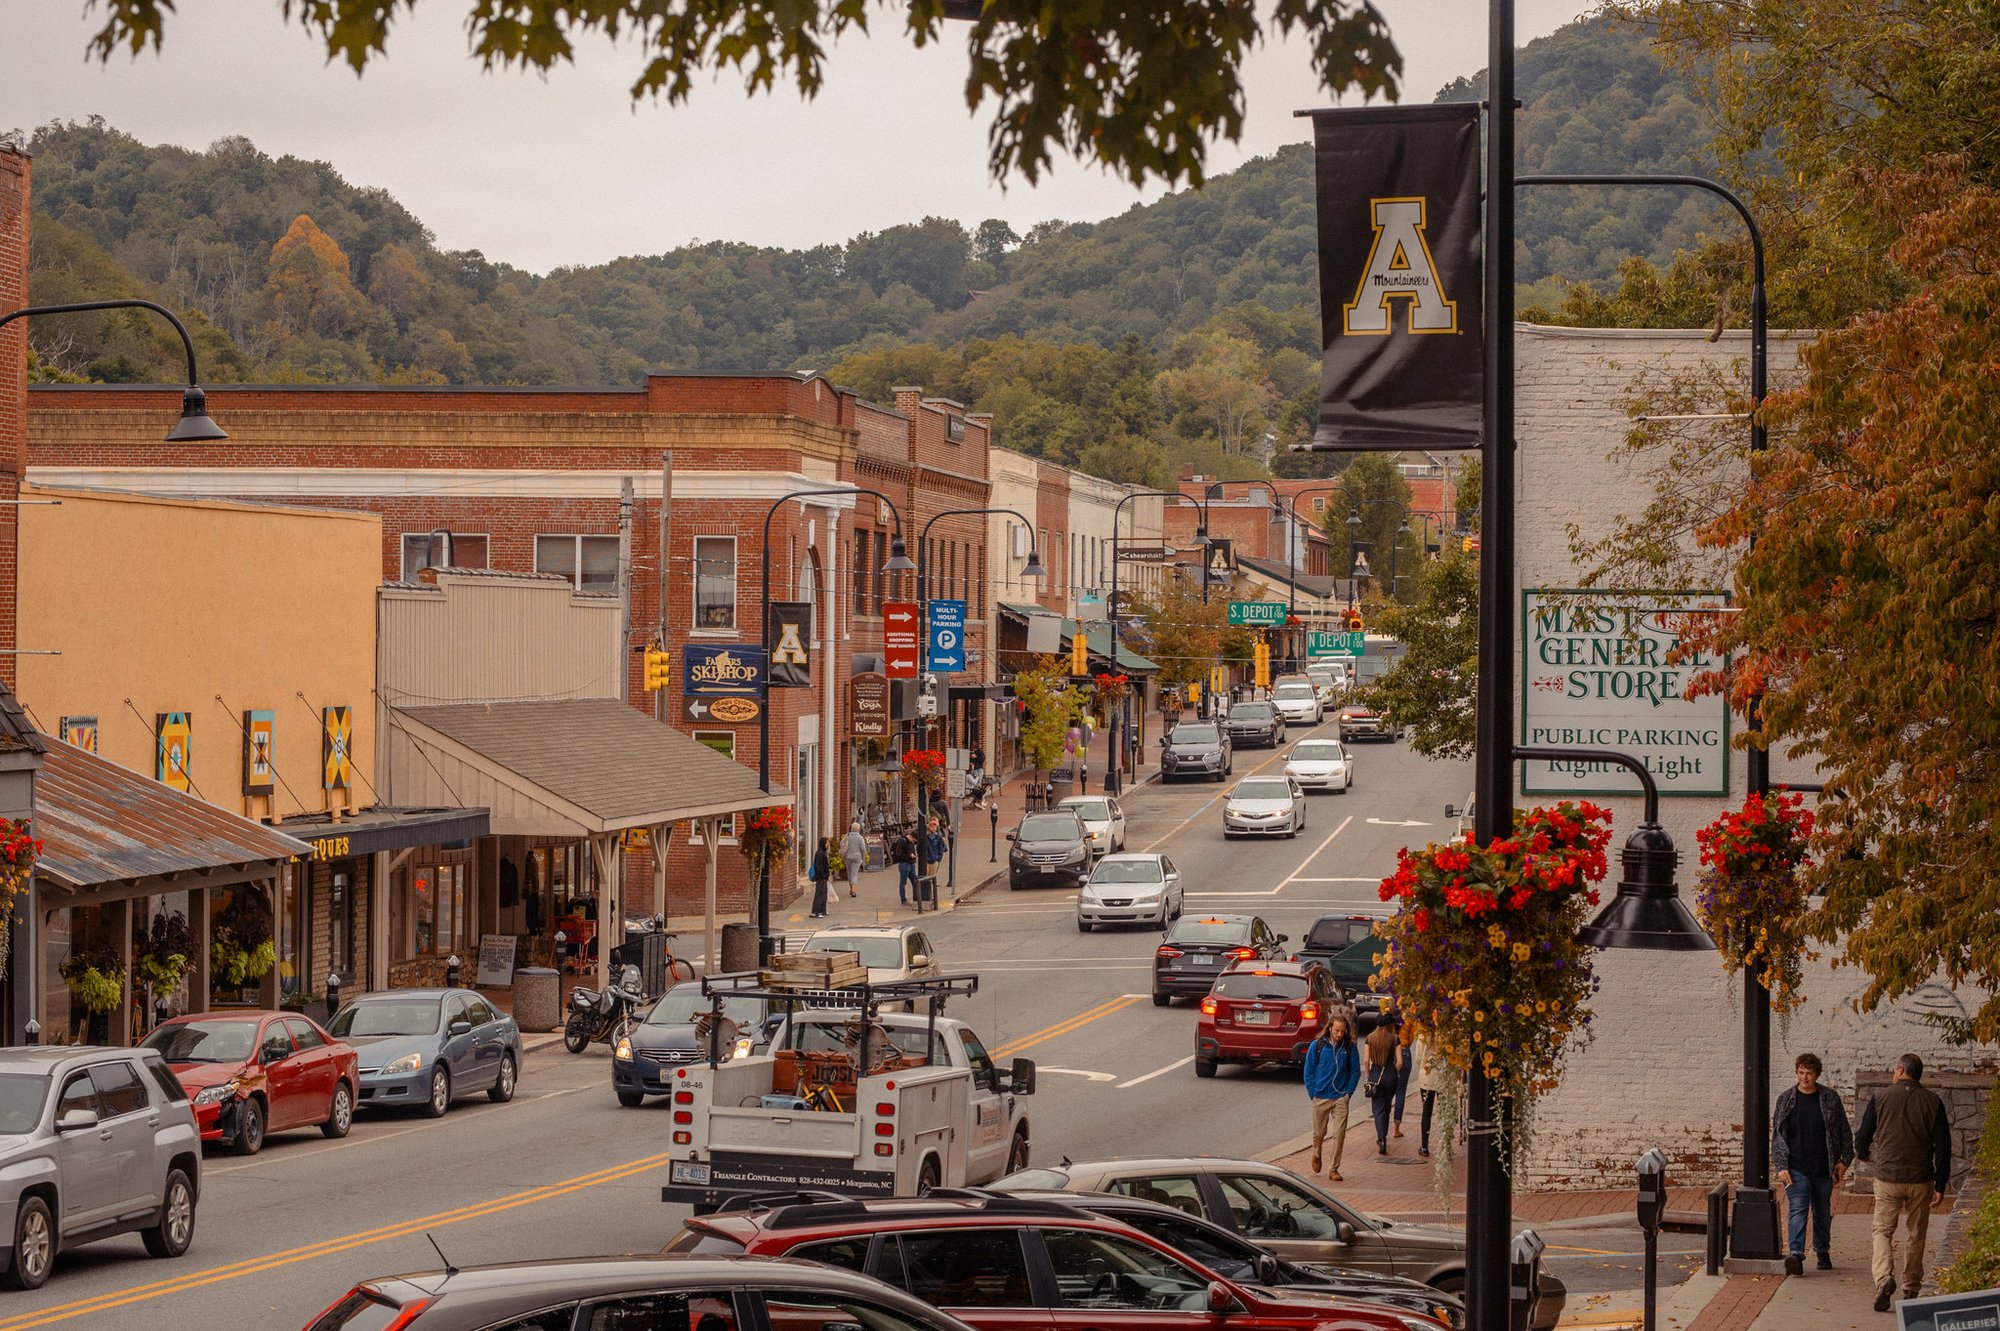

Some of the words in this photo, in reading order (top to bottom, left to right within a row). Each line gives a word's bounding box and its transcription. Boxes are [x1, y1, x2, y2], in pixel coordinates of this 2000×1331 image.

[1343, 196, 1457, 335] A
[1371, 273, 1429, 287] Mountaineers
[1210, 548, 1228, 568] A
[1231, 605, 1240, 618] S.
[1243, 606, 1274, 618] DEPOT
[772, 623, 807, 664] A
[1308, 633, 1316, 647] N
[1320, 633, 1351, 647] DEPOT
[1567, 671, 1681, 708] STORE
[857, 699, 882, 710] Yoga
[855, 722, 882, 732] Kindly
[1532, 728, 1611, 745] PUBLIC
[1616, 729, 1719, 746] PARKING
[1643, 755, 1702, 780] Light
[681, 1081, 703, 1089] 08-46
[712, 1171, 746, 1181] TRIANGLE
[747, 1173, 796, 1183] CONTRACTORS
[846, 1180, 880, 1189] Morganton,
[881, 1181, 892, 1189] NC
[1941, 1317, 1997, 1331] GALLERIES
